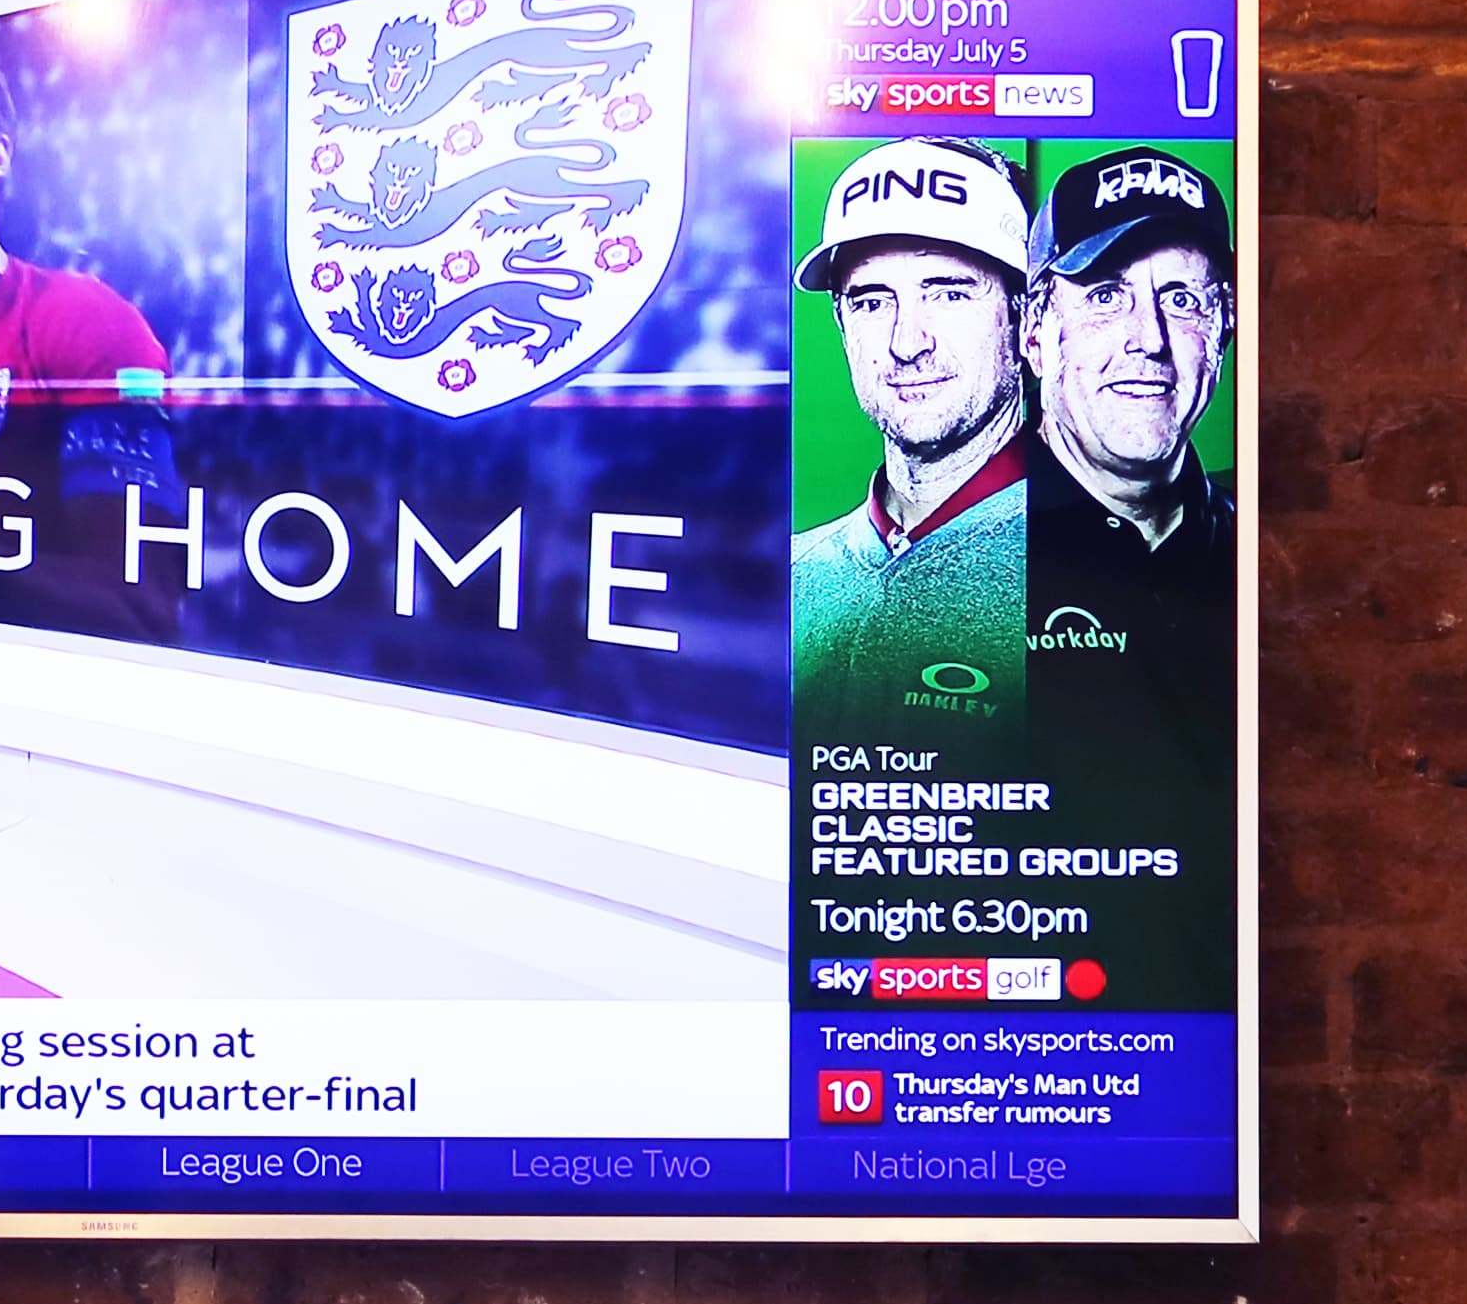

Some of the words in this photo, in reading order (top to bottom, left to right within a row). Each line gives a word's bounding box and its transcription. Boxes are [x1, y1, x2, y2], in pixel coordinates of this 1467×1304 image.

[823, 37, 946, 69] Thursday
[949, 37, 1005, 69] July
[1009, 37, 1029, 63] 5
[826, 77, 879, 113] sky
[887, 81, 991, 113] sports
[1004, 84, 1084, 106] news
[842, 167, 968, 218] PING
[1094, 168, 1206, 210] KPMG
[122, 483, 685, 652] HOME
[811, 744, 872, 772] PGA
[875, 744, 939, 772] Tour
[810, 781, 1051, 812] GREENBRIER
[810, 814, 974, 844] CLASSIC
[810, 847, 1010, 876] FEATURED
[1018, 847, 1179, 877] GROUPS
[810, 898, 946, 942] Tonight
[951, 898, 1089, 942] 6.30pm
[816, 961, 871, 996] sky
[878, 962, 984, 997] sports
[995, 964, 1053, 996] golf
[37, 1022, 199, 1059] session
[211, 1026, 256, 1060] at
[819, 1026, 937, 1057] Trending
[942, 1033, 977, 1052] on
[983, 1026, 1175, 1057] skysports.com
[139, 1077, 419, 1121] quarter-final
[826, 1079, 873, 1113] 10
[892, 1072, 1029, 1100] Thursday's
[1033, 1073, 1086, 1096] Man
[1090, 1072, 1141, 1096] Utd
[894, 1101, 1000, 1125] transfer
[1004, 1103, 1113, 1125] rumours
[161, 1146, 285, 1184] League
[292, 1147, 363, 1179] One
[512, 1148, 634, 1185] League
[641, 1148, 712, 1179] Two
[852, 1149, 997, 1181] National
[1007, 1150, 1068, 1188] Lge
